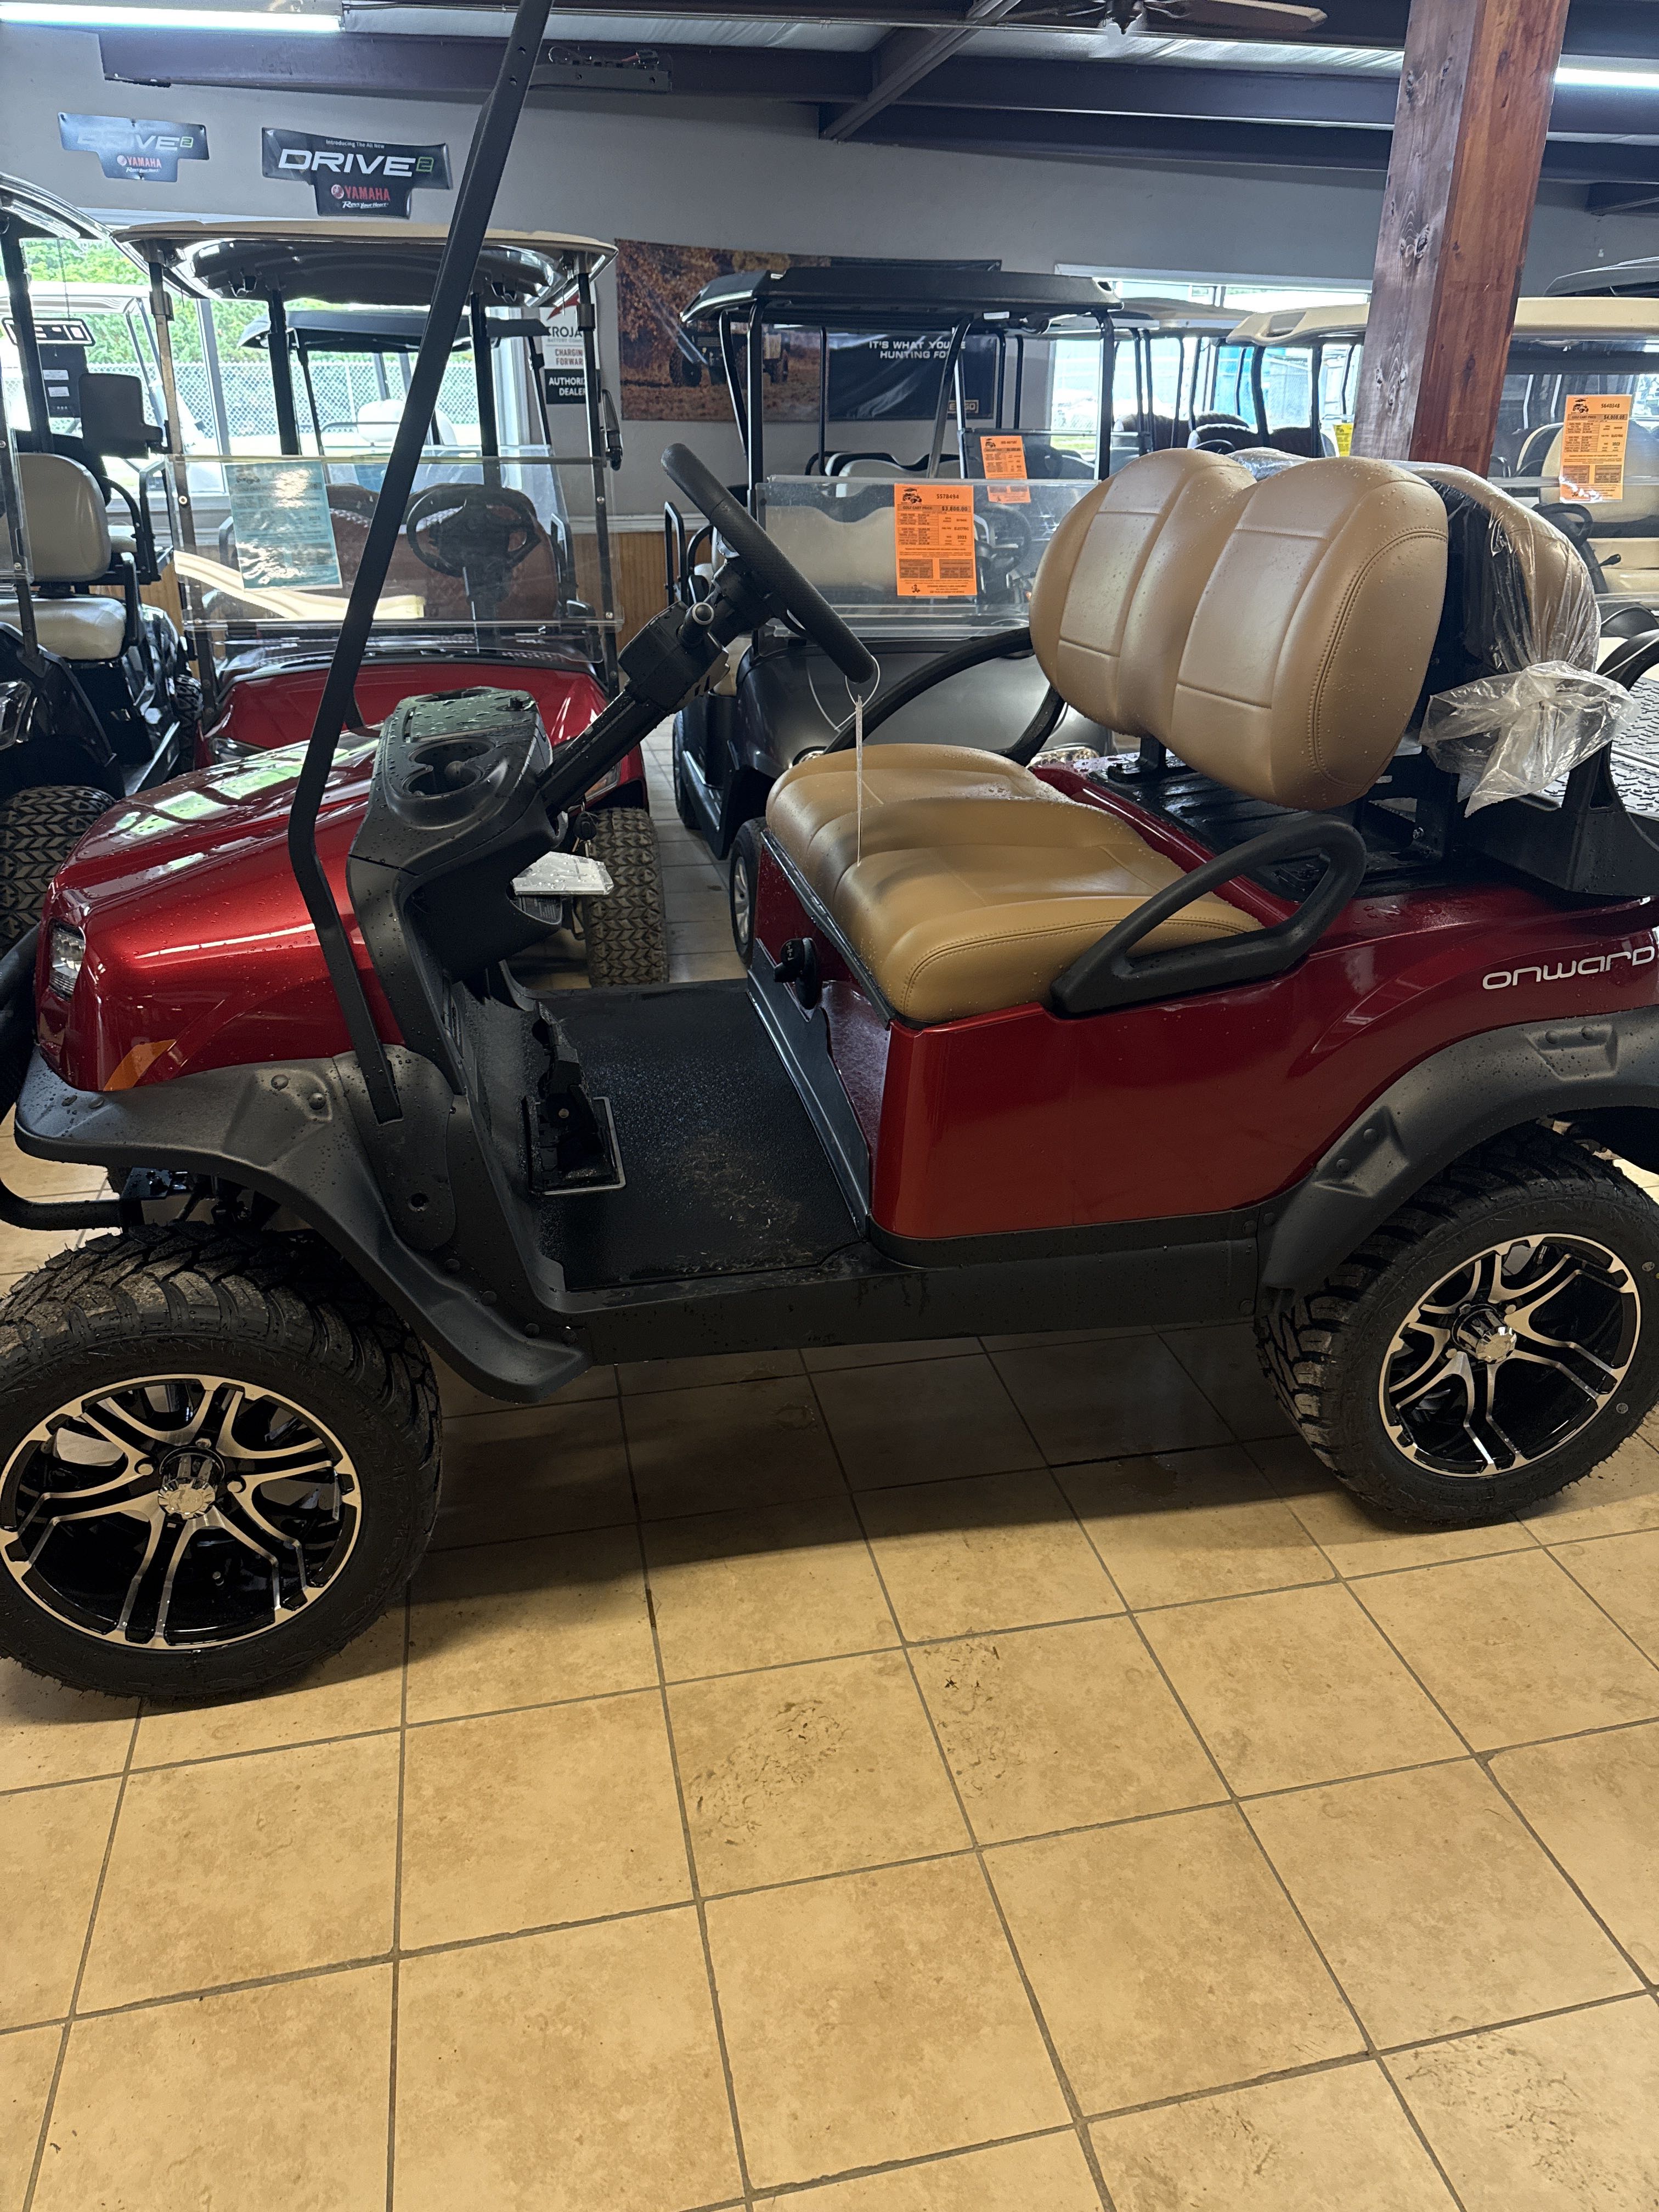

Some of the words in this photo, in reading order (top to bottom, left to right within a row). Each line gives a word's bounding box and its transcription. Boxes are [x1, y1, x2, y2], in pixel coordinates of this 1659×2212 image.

[325, 139, 356, 148] Introducing
[127, 156, 162, 168] YAMAHA
[344, 184, 391, 201] YAMAHA
[548, 326, 583, 337] ROJA
[869, 341, 889, 349] IT'S
[893, 341, 924, 349] WHAT
[929, 341, 966, 349] YOUE
[880, 351, 930, 359] HUNTING
[549, 376, 585, 386] AUTHORI
